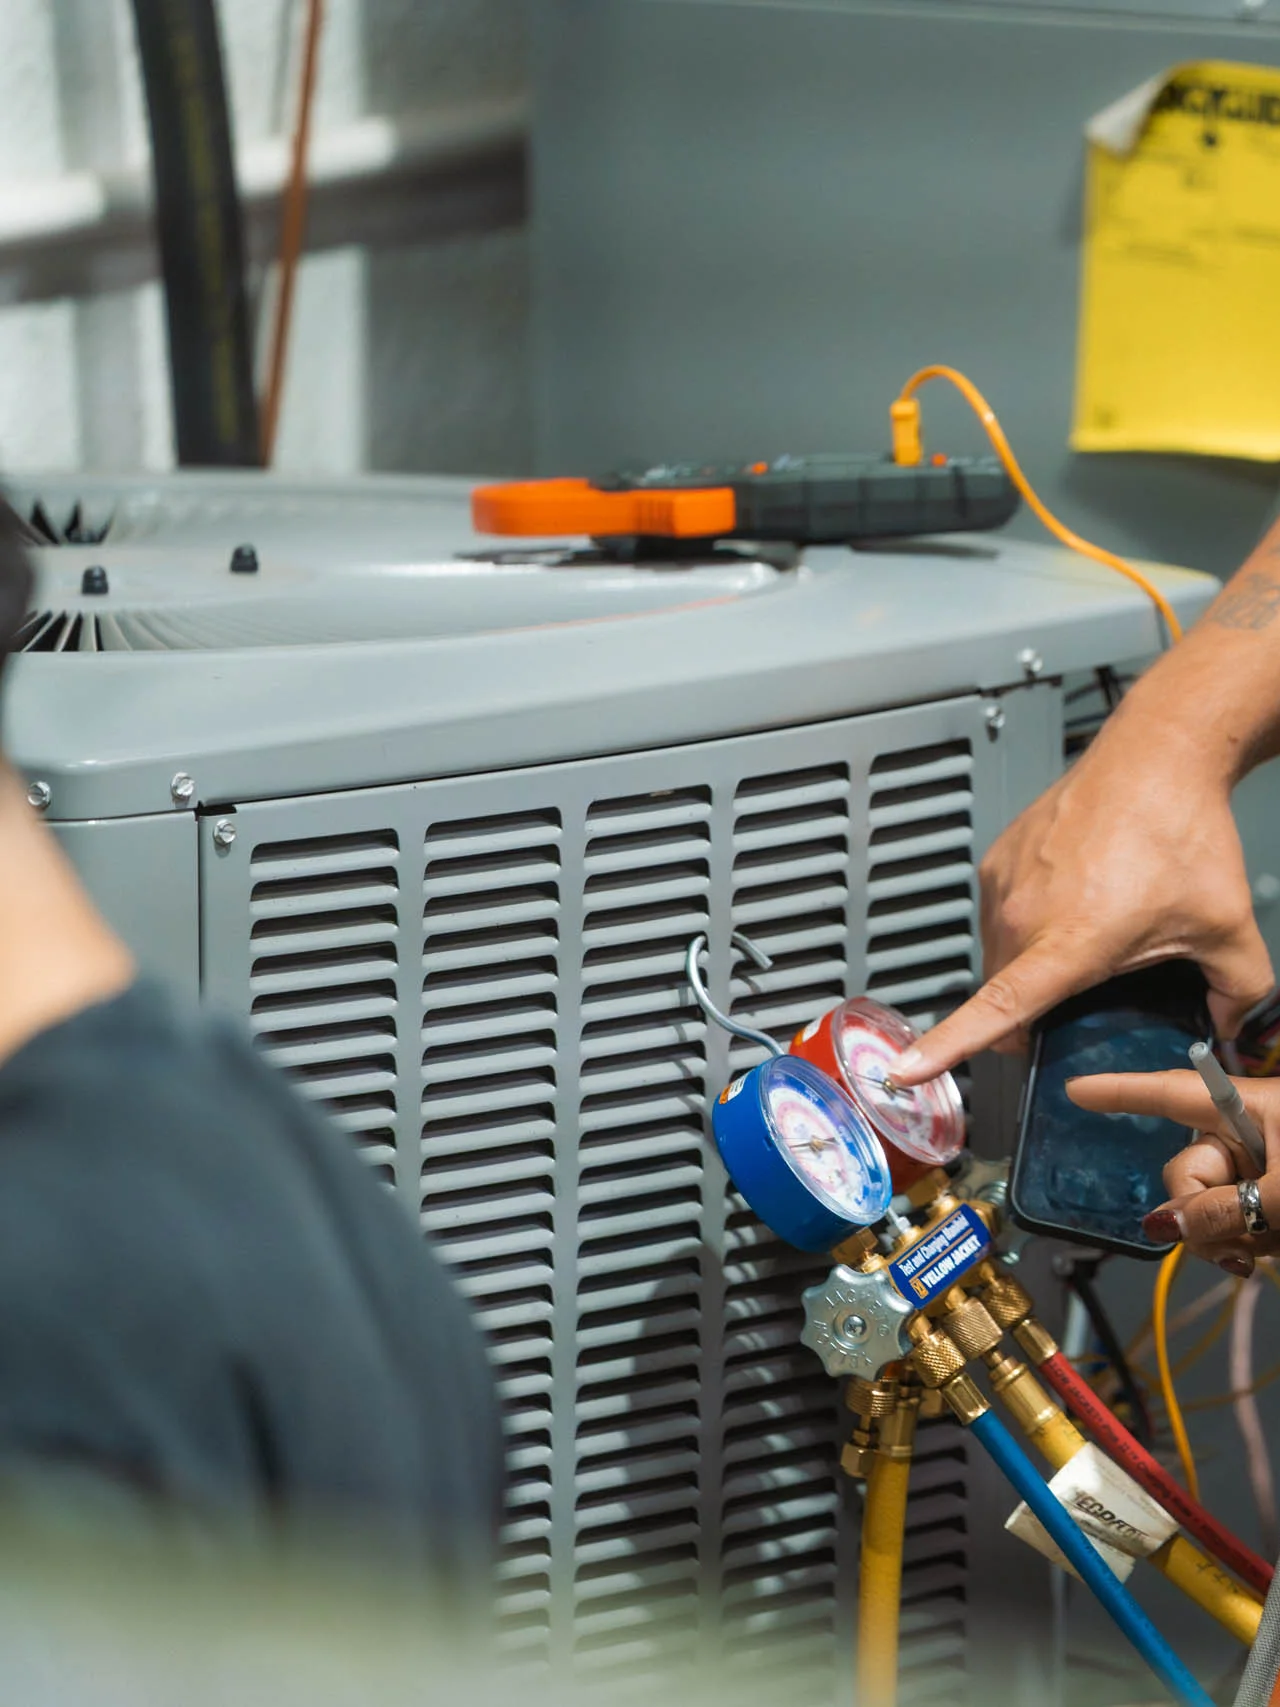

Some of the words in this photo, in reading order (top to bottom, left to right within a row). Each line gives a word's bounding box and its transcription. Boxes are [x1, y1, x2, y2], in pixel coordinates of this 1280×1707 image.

[898, 1259, 916, 1277] Test
[920, 1255, 956, 1289] YELLOW
[950, 1234, 982, 1266] JACKET
